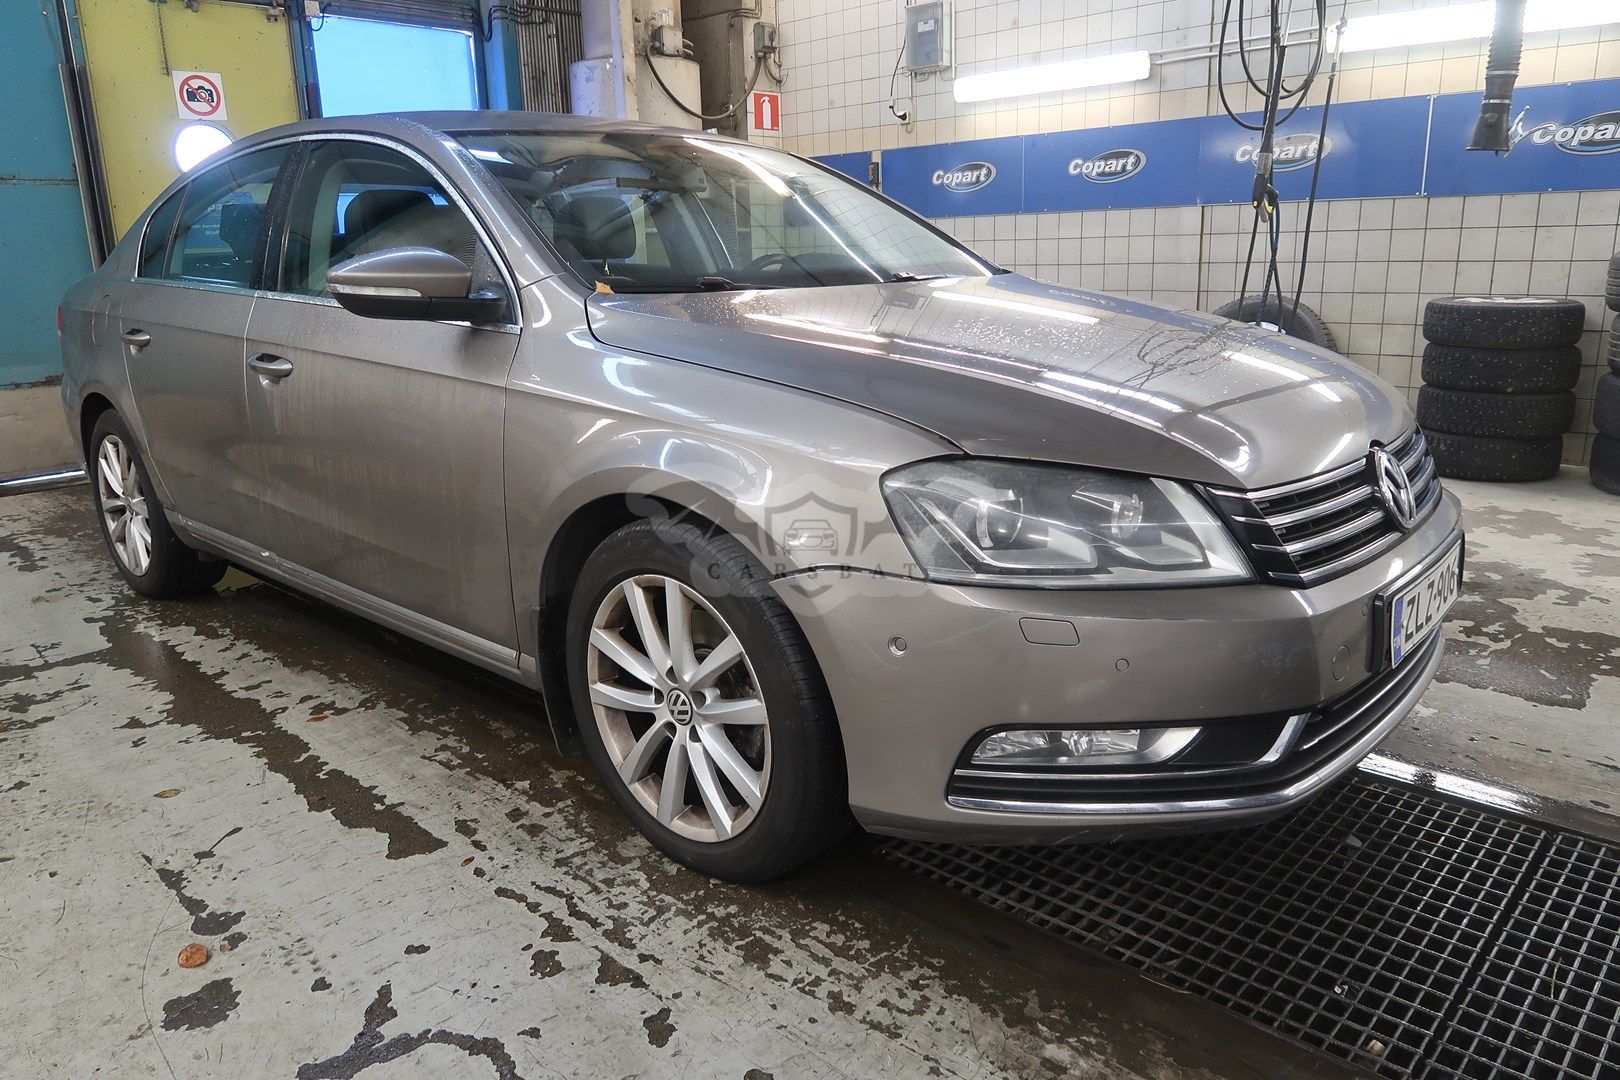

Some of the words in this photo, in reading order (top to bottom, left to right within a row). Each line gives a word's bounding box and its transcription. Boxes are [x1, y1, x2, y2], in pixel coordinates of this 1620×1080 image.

[1069, 153, 1137, 176] Copart
[933, 167, 989, 187] Copart
[1405, 555, 1458, 643] ZLZ-906
